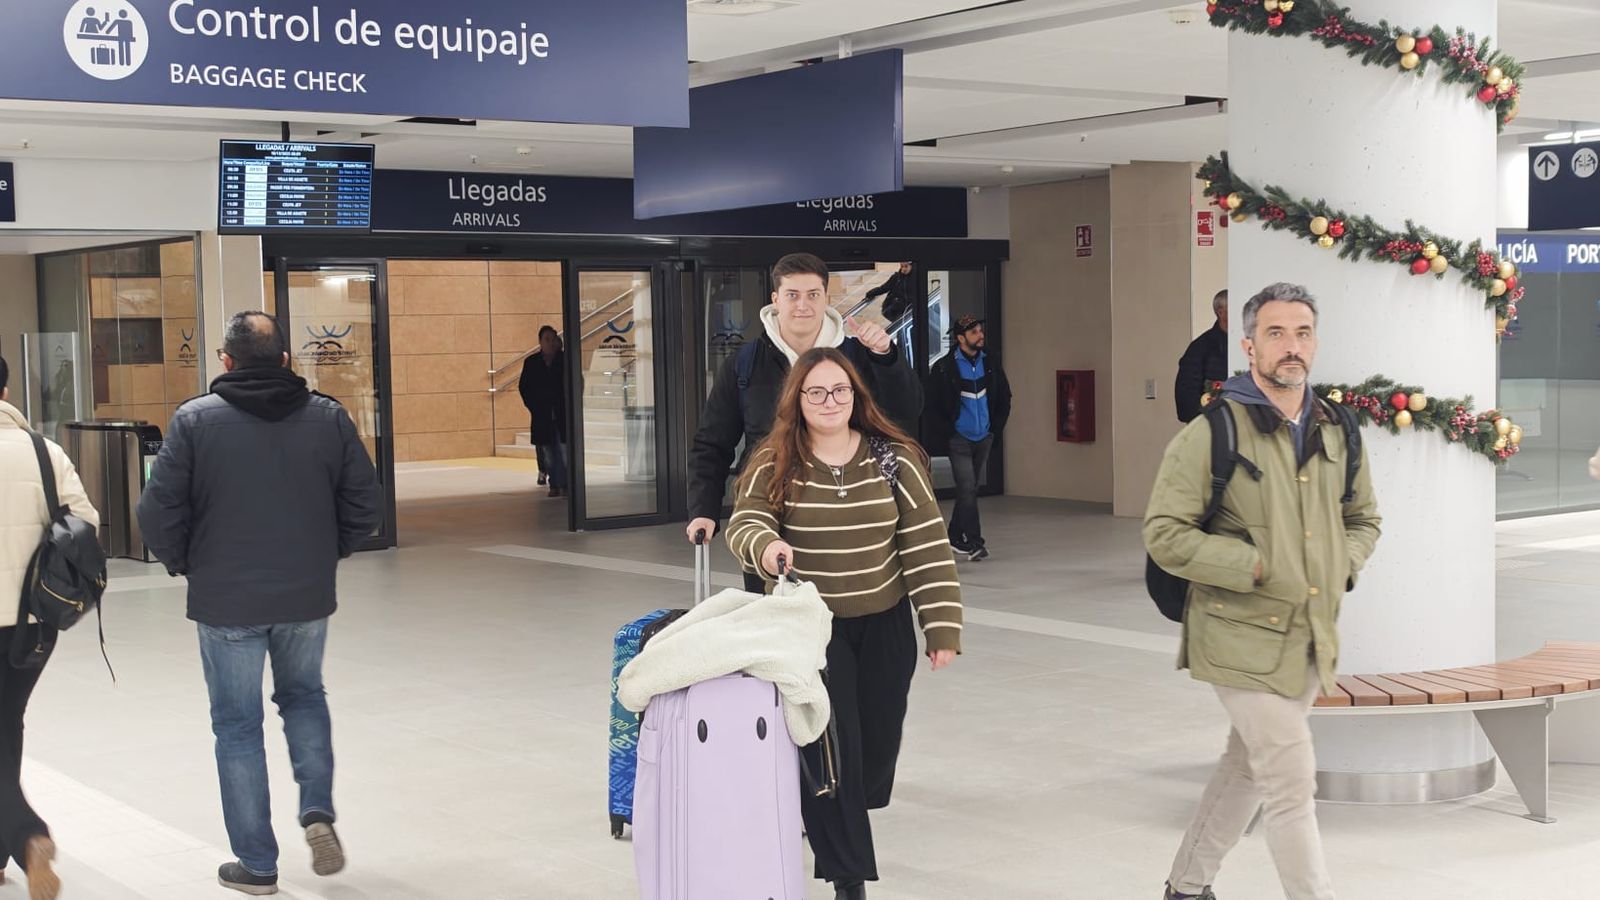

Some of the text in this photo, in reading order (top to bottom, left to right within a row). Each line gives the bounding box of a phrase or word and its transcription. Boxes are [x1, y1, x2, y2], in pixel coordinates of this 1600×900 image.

[168, 0, 549, 65] Control de equipaje
[170, 63, 367, 93] BAGGAGE CHECK
[448, 177, 547, 206] Llegadas
[452, 212, 521, 227] ARRIVALS
[823, 219, 878, 232] ARRIVALS
[1567, 243, 1600, 264] POR
